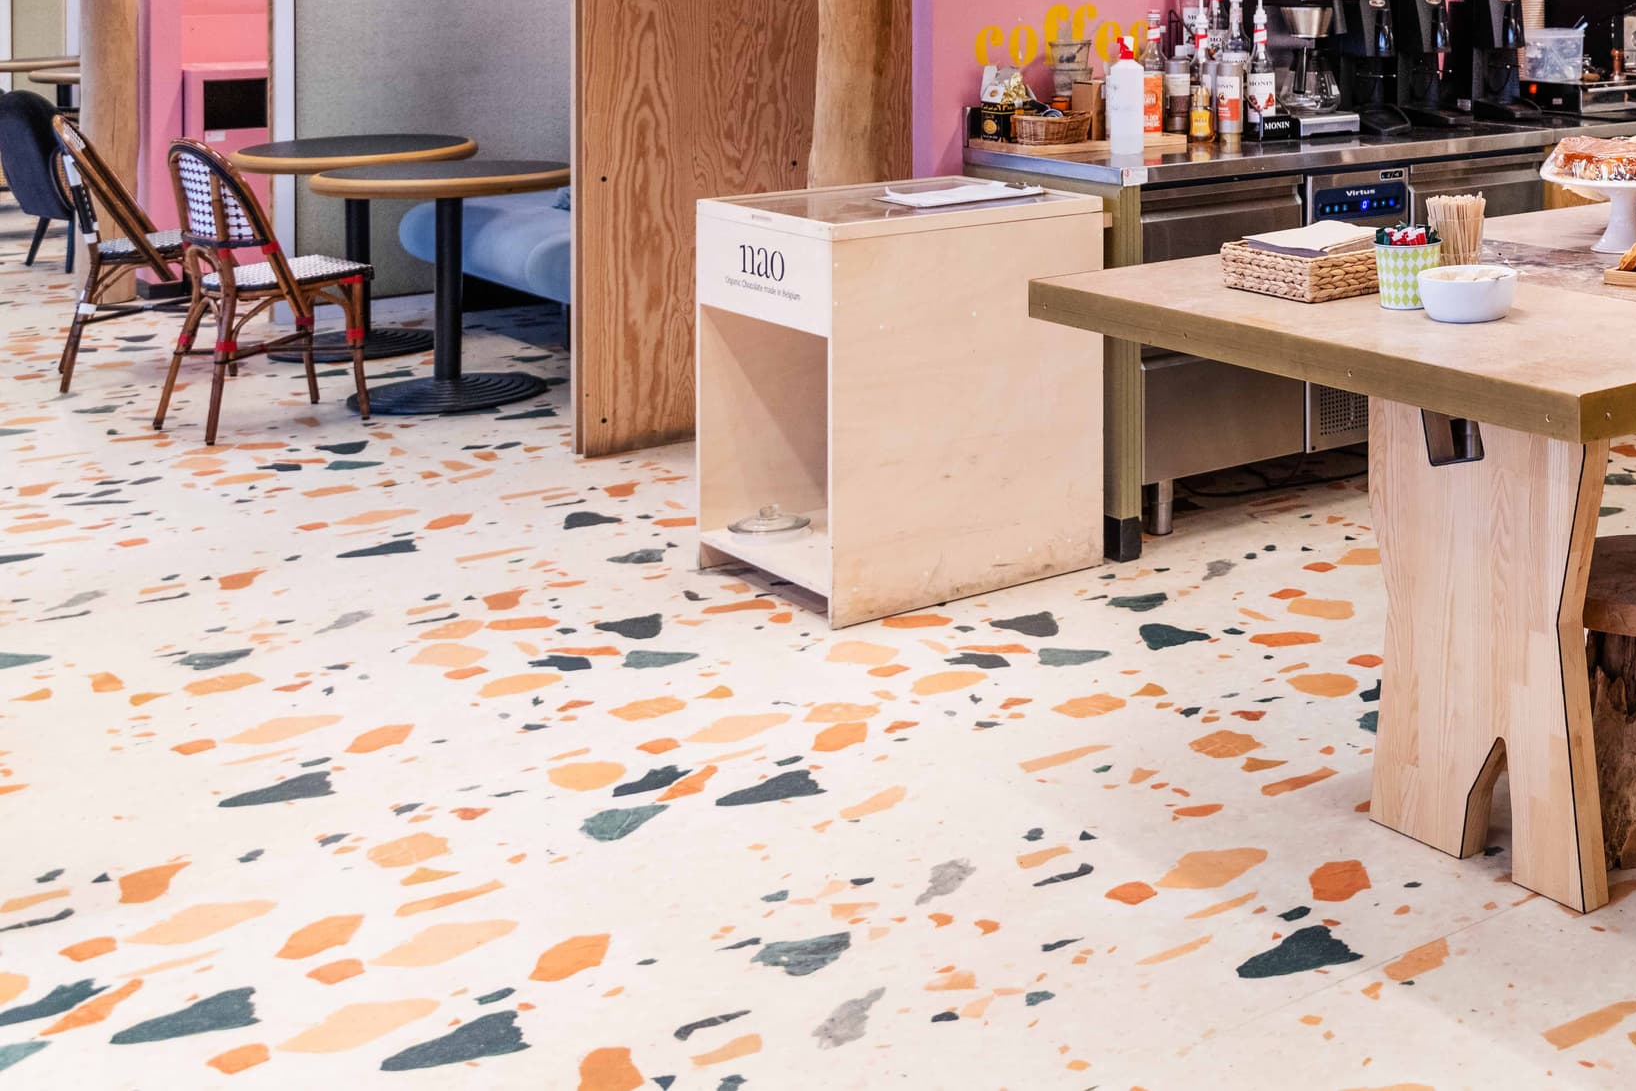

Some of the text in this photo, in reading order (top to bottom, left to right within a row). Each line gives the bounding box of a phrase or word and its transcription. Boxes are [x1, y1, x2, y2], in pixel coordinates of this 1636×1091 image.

[1249, 79, 1273, 87] MONIN
[1264, 120, 1291, 131] MONIN
[1345, 189, 1376, 197] Virtus
[739, 244, 785, 282] nao
